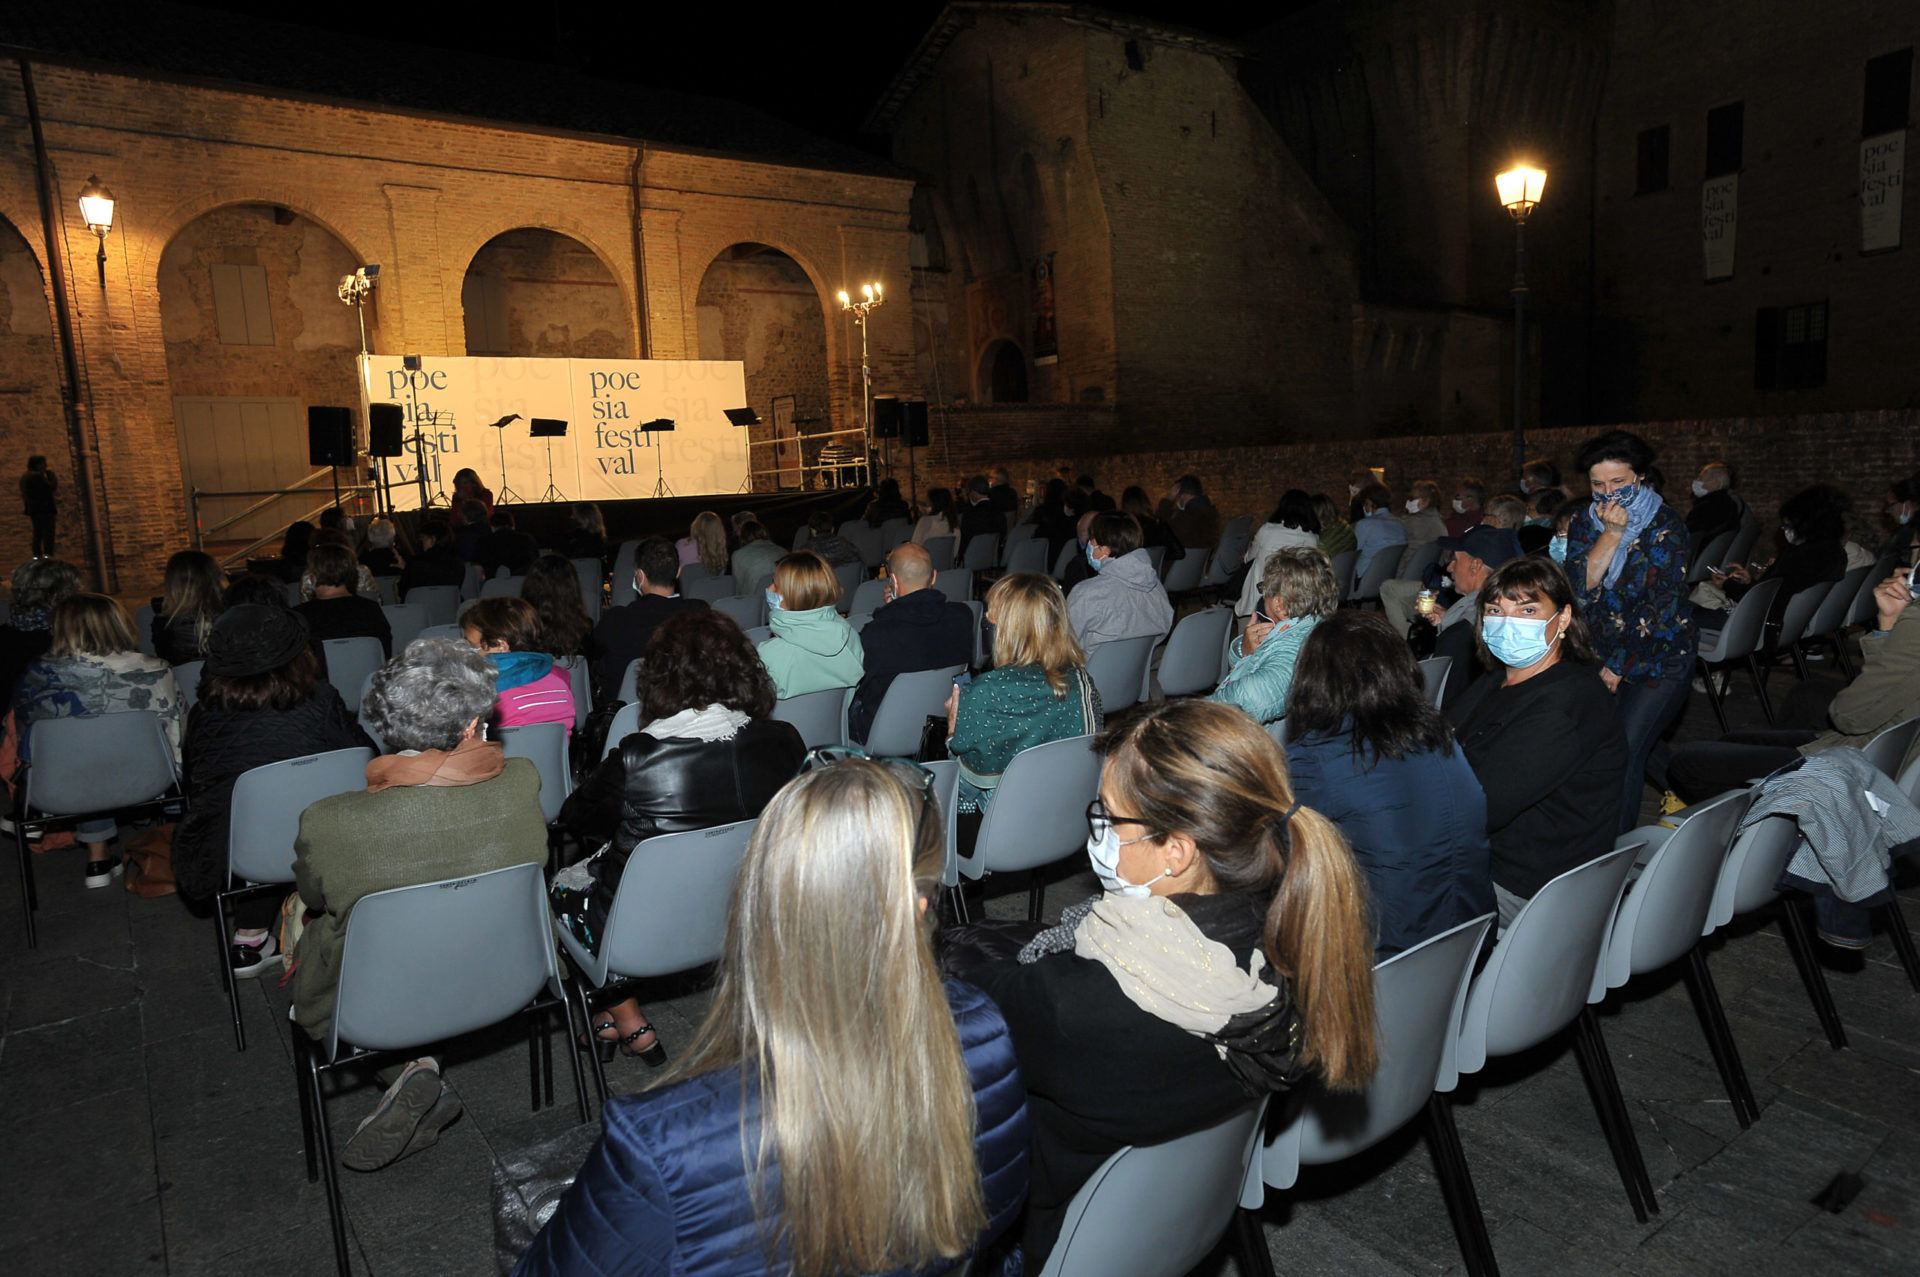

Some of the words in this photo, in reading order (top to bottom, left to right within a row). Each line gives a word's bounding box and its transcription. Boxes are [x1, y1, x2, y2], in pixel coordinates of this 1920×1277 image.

[386, 369, 448, 399] poe
[589, 371, 642, 399] poe
[393, 394, 436, 422] ia
[592, 393, 631, 419] sia
[403, 425, 460, 454] esti
[596, 448, 639, 475] val
